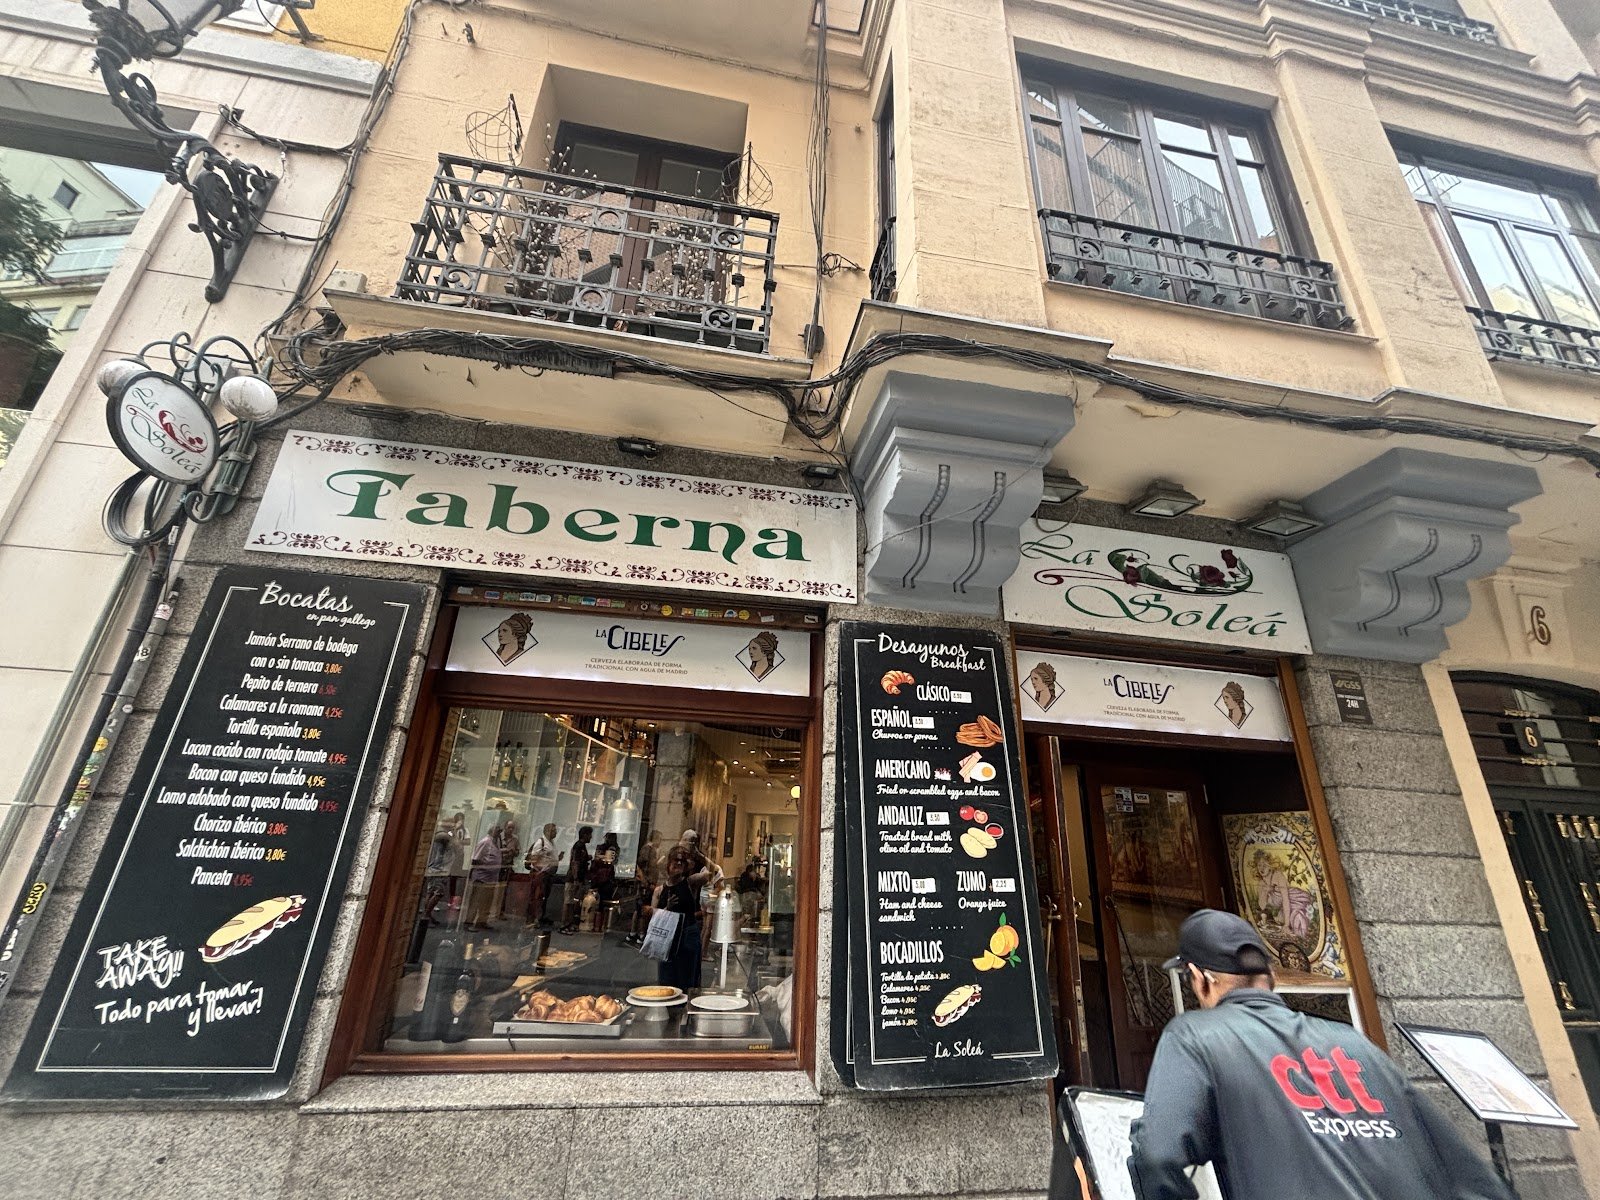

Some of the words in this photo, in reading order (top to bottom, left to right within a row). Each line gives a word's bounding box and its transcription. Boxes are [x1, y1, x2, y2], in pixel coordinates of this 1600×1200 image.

[132, 387, 159, 410] La
[131, 415, 200, 474] Soleá
[325, 469, 812, 566] Taberna
[1019, 533, 1100, 566] La
[259, 580, 354, 613] Bocatas
[306, 613, 320, 622] en
[317, 615, 339, 626] pan
[341, 613, 376, 630] gallego
[1064, 584, 1288, 637] Soleá
[1531, 605, 1551, 645] 6
[245, 630, 276, 648] Jamón
[276, 632, 312, 650] Serrano
[313, 636, 325, 651] de
[326, 636, 359, 657] bodega
[595, 629, 607, 638] LA
[607, 625, 686, 657] CIBELES
[878, 632, 969, 663] Desayunos
[250, 656, 267, 668] con
[267, 659, 275, 668] o
[276, 655, 290, 670] sin
[290, 658, 324, 673] tomaca
[585, 663, 624, 672] TRADICIONAL
[590, 657, 616, 665] CERVEZA
[618, 659, 653, 667] ELABORADA
[931, 656, 986, 672] Breakfast
[241, 673, 270, 691] Pepito
[271, 675, 284, 692] de
[284, 678, 319, 694] ternera
[917, 681, 950, 702] CLÁSICO
[1103, 678, 1113, 687] LA
[1113, 674, 1175, 705] CIBELES
[220, 694, 268, 713] Calamares
[269, 702, 276, 713] a
[277, 697, 289, 714] la
[290, 703, 325, 717] romana
[871, 706, 912, 728] ESPAÑOL
[227, 718, 259, 736] Tortilla
[260, 721, 302, 739] española
[302, 728, 321, 740] 3,80€
[872, 729, 903, 740] Churros
[914, 734, 938, 743] porras
[1525, 726, 1537, 748] 6
[182, 738, 211, 756] Lacon
[212, 740, 242, 758] cocido
[244, 747, 261, 759] con
[262, 743, 293, 764] rodaja
[294, 747, 327, 763] tomate
[188, 763, 219, 781] Bacon
[220, 769, 238, 782] con
[239, 773, 270, 786] queso
[270, 766, 306, 786] fundido
[875, 759, 931, 779] AMERICANO
[157, 787, 186, 804] Lomo
[187, 787, 231, 807] adobado
[232, 795, 249, 808] con
[251, 797, 281, 811] queso
[281, 791, 318, 812] fundido
[876, 784, 898, 795] Fried
[909, 785, 946, 796] scrambled
[947, 789, 964, 800] eggs
[965, 786, 979, 796] and
[979, 786, 1000, 797] bacon
[194, 813, 232, 832] Chorizo
[232, 814, 267, 835] ibérico
[878, 805, 924, 826] ANDALUZ
[879, 830, 910, 842] Toasted
[911, 831, 933, 842] bread
[933, 831, 952, 842] with
[176, 839, 230, 859] Salchichón
[230, 840, 265, 860] ibérico
[265, 849, 287, 862] 3,80€
[879, 843, 898, 854] olive
[899, 843, 909, 853] oil
[910, 843, 925, 854] and
[926, 844, 953, 854] tomato
[191, 866, 233, 886] Panceta
[878, 871, 910, 893] MIXTO
[956, 871, 986, 892] ZUMO
[879, 898, 901, 910] Ham
[901, 898, 917, 909] and
[917, 898, 943, 909] cheese
[958, 897, 987, 913] Orange
[987, 899, 1007, 910] juice
[878, 911, 916, 922] sandwich
[98, 935, 168, 969] TAKE
[880, 940, 944, 965] BOCADILLOS
[880, 971, 905, 982] Tortilla
[905, 971, 914, 980] de
[914, 971, 934, 983] patata
[881, 982, 914, 994] Calamares
[94, 998, 142, 1025] Todo
[146, 991, 192, 1024] para
[880, 994, 900, 1004] Bacon
[881, 1005, 898, 1015] Lomo
[187, 1009, 201, 1037] y
[881, 1017, 901, 1030] jamón
[935, 1041, 951, 1058] La
[953, 1038, 984, 1058] Soleá
[1269, 1045, 1386, 1114] ctt
[1301, 1109, 1397, 1141] Express
